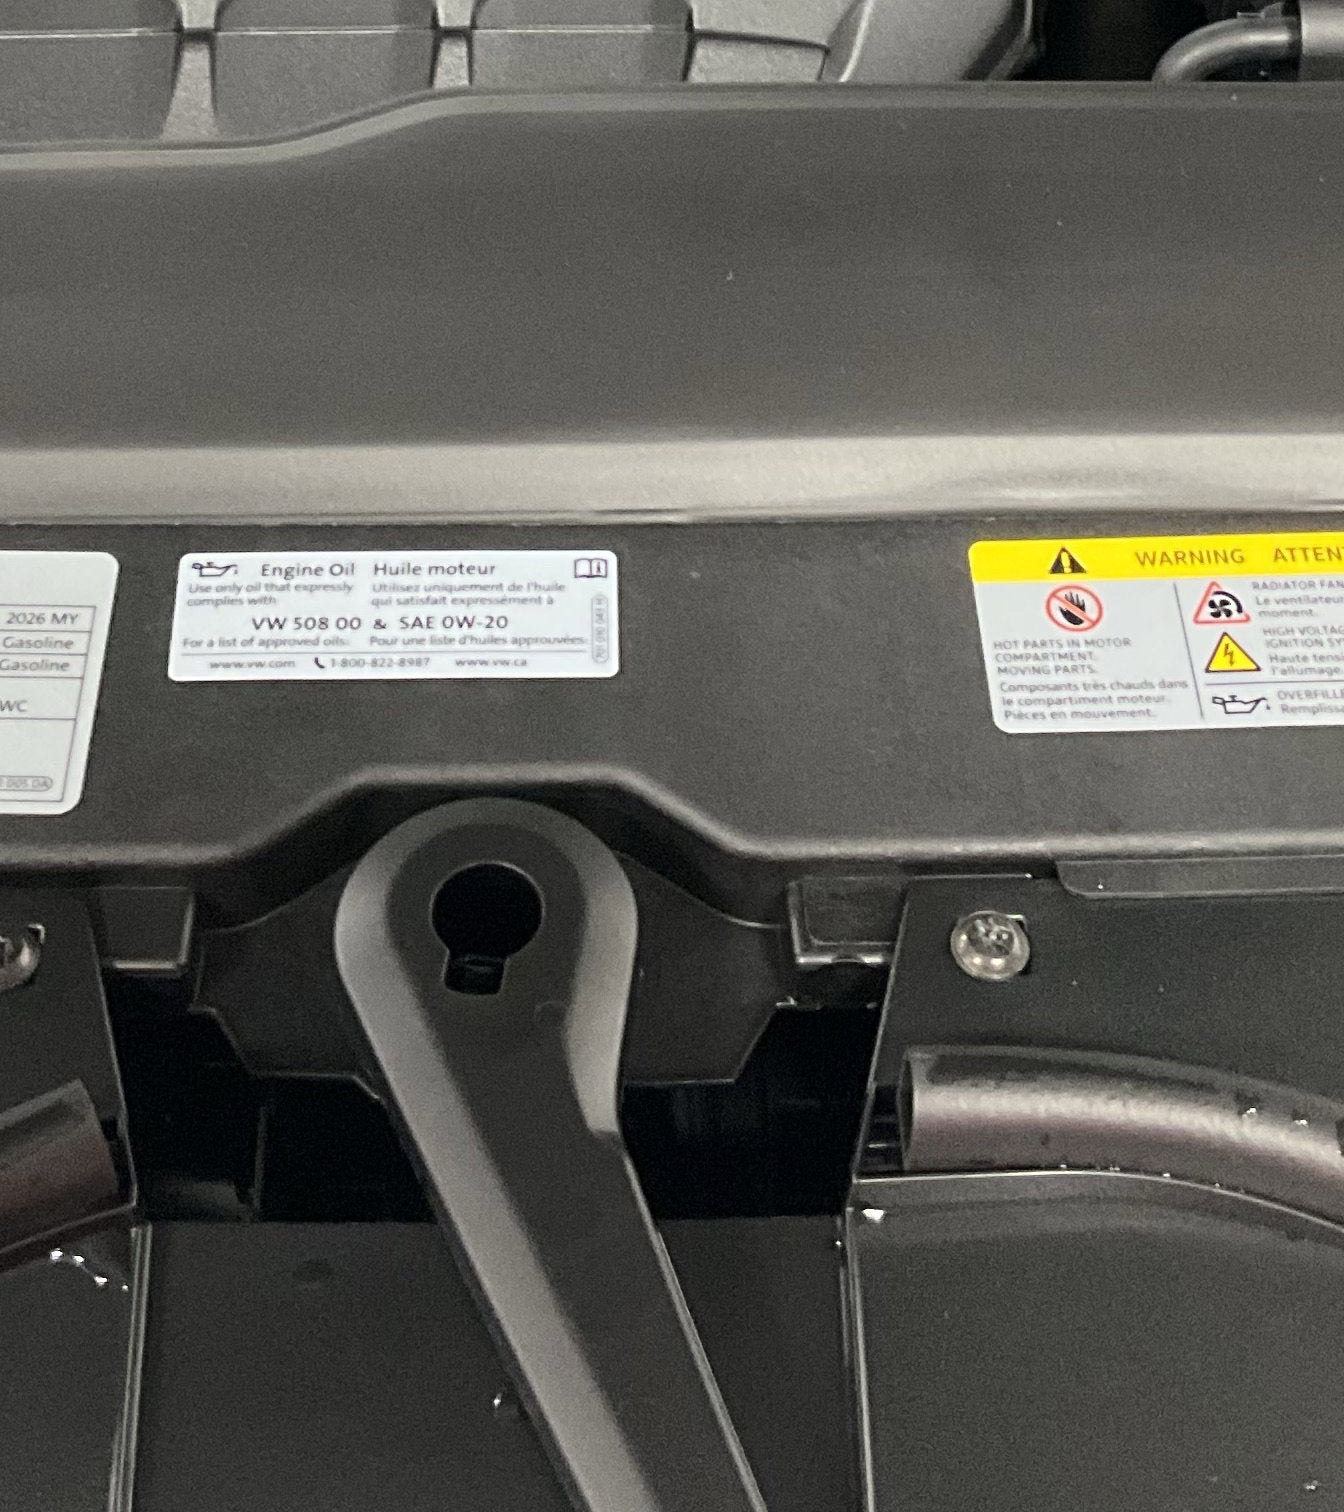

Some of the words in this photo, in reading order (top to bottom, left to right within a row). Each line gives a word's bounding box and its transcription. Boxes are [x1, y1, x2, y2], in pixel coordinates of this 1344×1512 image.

[1135, 548, 1246, 568] WARNING
[261, 563, 324, 581] Engine
[329, 562, 355, 577] Oil
[374, 562, 422, 576] Huile
[428, 563, 496, 576] moteur
[188, 583, 213, 594] Use
[215, 582, 243, 595] only
[245, 582, 261, 593] oil
[264, 582, 291, 592] that
[294, 582, 353, 595] expressly
[372, 582, 420, 593] Utilisez
[424, 583, 504, 595] uniquement
[507, 582, 524, 593] de
[527, 582, 566, 593] l'huile
[1251, 580, 1316, 590] RADIATOR
[1319, 579, 1344, 589] FAN
[186, 596, 244, 608] complies
[247, 595, 277, 606] with
[372, 596, 393, 609] qui
[396, 595, 447, 606] satisfait
[451, 594, 542, 608] expressément
[546, 595, 554, 605] à
[1256, 595, 1269, 606] Le
[1274, 594, 1344, 605] ventilateur
[6, 611, 46, 625] 2026
[51, 613, 79, 625] MY
[252, 617, 288, 630] VW
[293, 616, 329, 630] 508
[335, 617, 362, 630] 00
[373, 618, 387, 630] &
[399, 616, 435, 630] SAE
[442, 615, 509, 630] 0W-20
[1262, 625, 1295, 636] HIGH
[2, 636, 75, 650] Gasoline
[182, 637, 204, 648] For
[206, 639, 214, 648] a
[218, 637, 237, 648] list
[240, 636, 256, 648] of
[258, 636, 320, 649] approved
[370, 635, 398, 646] Pour
[402, 637, 426, 646] une
[429, 635, 456, 646] liste
[458, 635, 507, 646] d'huiles
[993, 640, 1019, 650] HOT
[1024, 639, 1064, 649] PARTS
[1067, 638, 1081, 649] IN
[1084, 638, 1132, 648] MOTOR
[1265, 638, 1324, 649] IGNITION
[209, 659, 296, 669] www.vw.com
[330, 656, 430, 669] 1-800-822-8987
[455, 656, 527, 667] www.vw.ca
[1268, 653, 1306, 664] Haute
[997, 665, 1051, 676] MOVING
[1000, 682, 1079, 694] Composants
[1083, 680, 1106, 691] très
[1110, 679, 1156, 690] chauds
[1158, 678, 1189, 690] dans
[1002, 696, 1014, 707] le
[1018, 695, 1113, 708] compartiment
[1050, 710, 1067, 719] en
